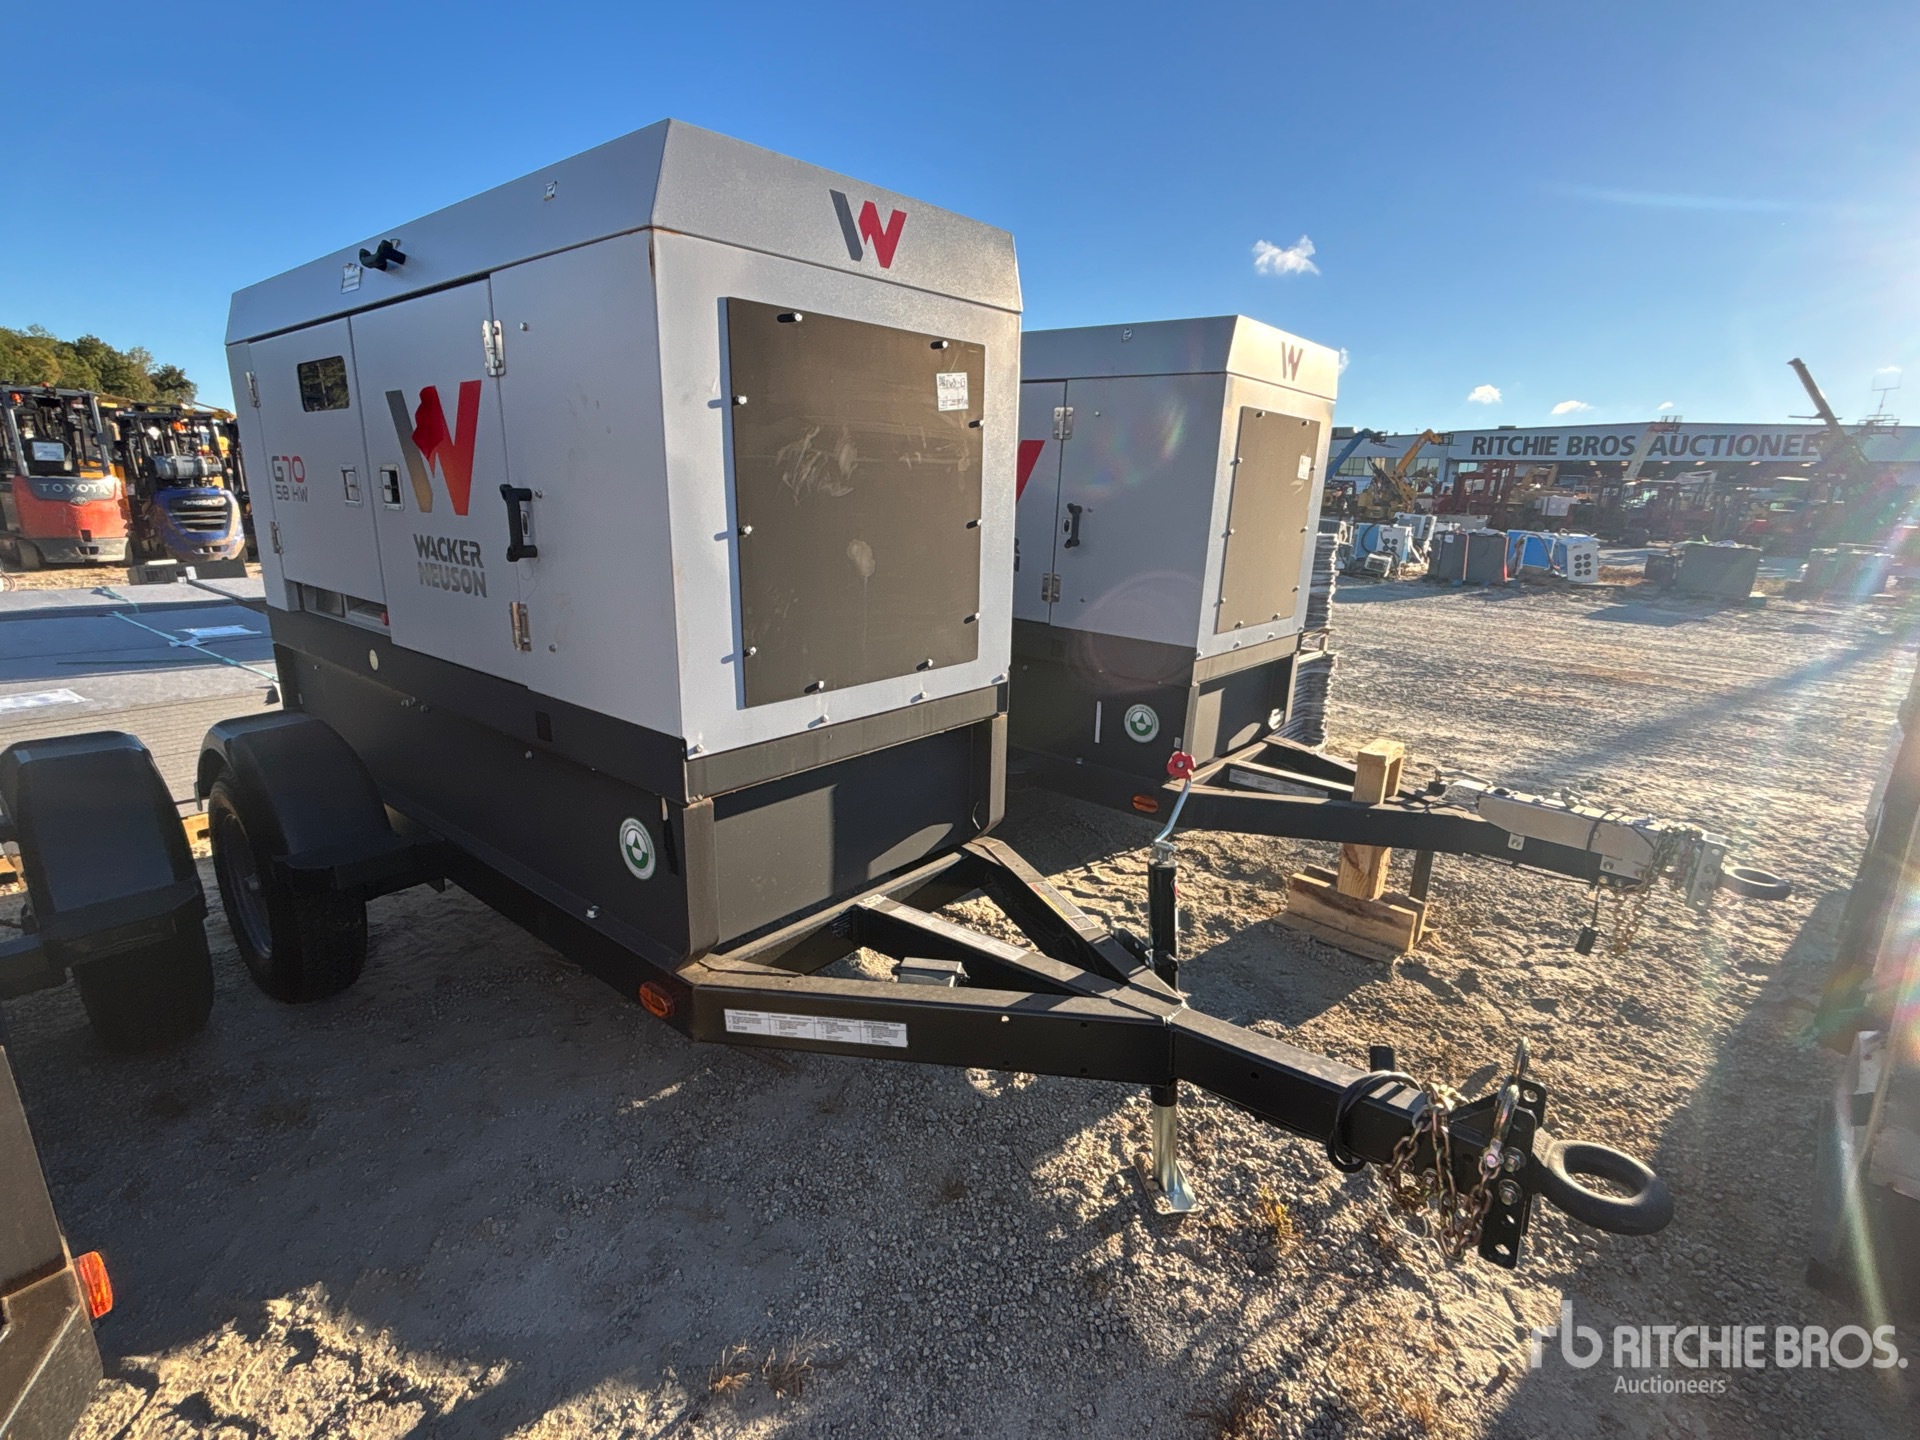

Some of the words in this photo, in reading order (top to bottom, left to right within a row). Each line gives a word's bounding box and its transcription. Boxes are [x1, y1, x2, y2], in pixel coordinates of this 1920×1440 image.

[1471, 436, 1560, 456] RITCHIE
[1647, 434, 1818, 457] AUCTIONEE
[271, 455, 305, 484] G70
[39, 483, 110, 495] TOYOTA
[275, 484, 290, 501] 58
[413, 533, 484, 568] WACKER
[418, 561, 487, 598] NEUSON
